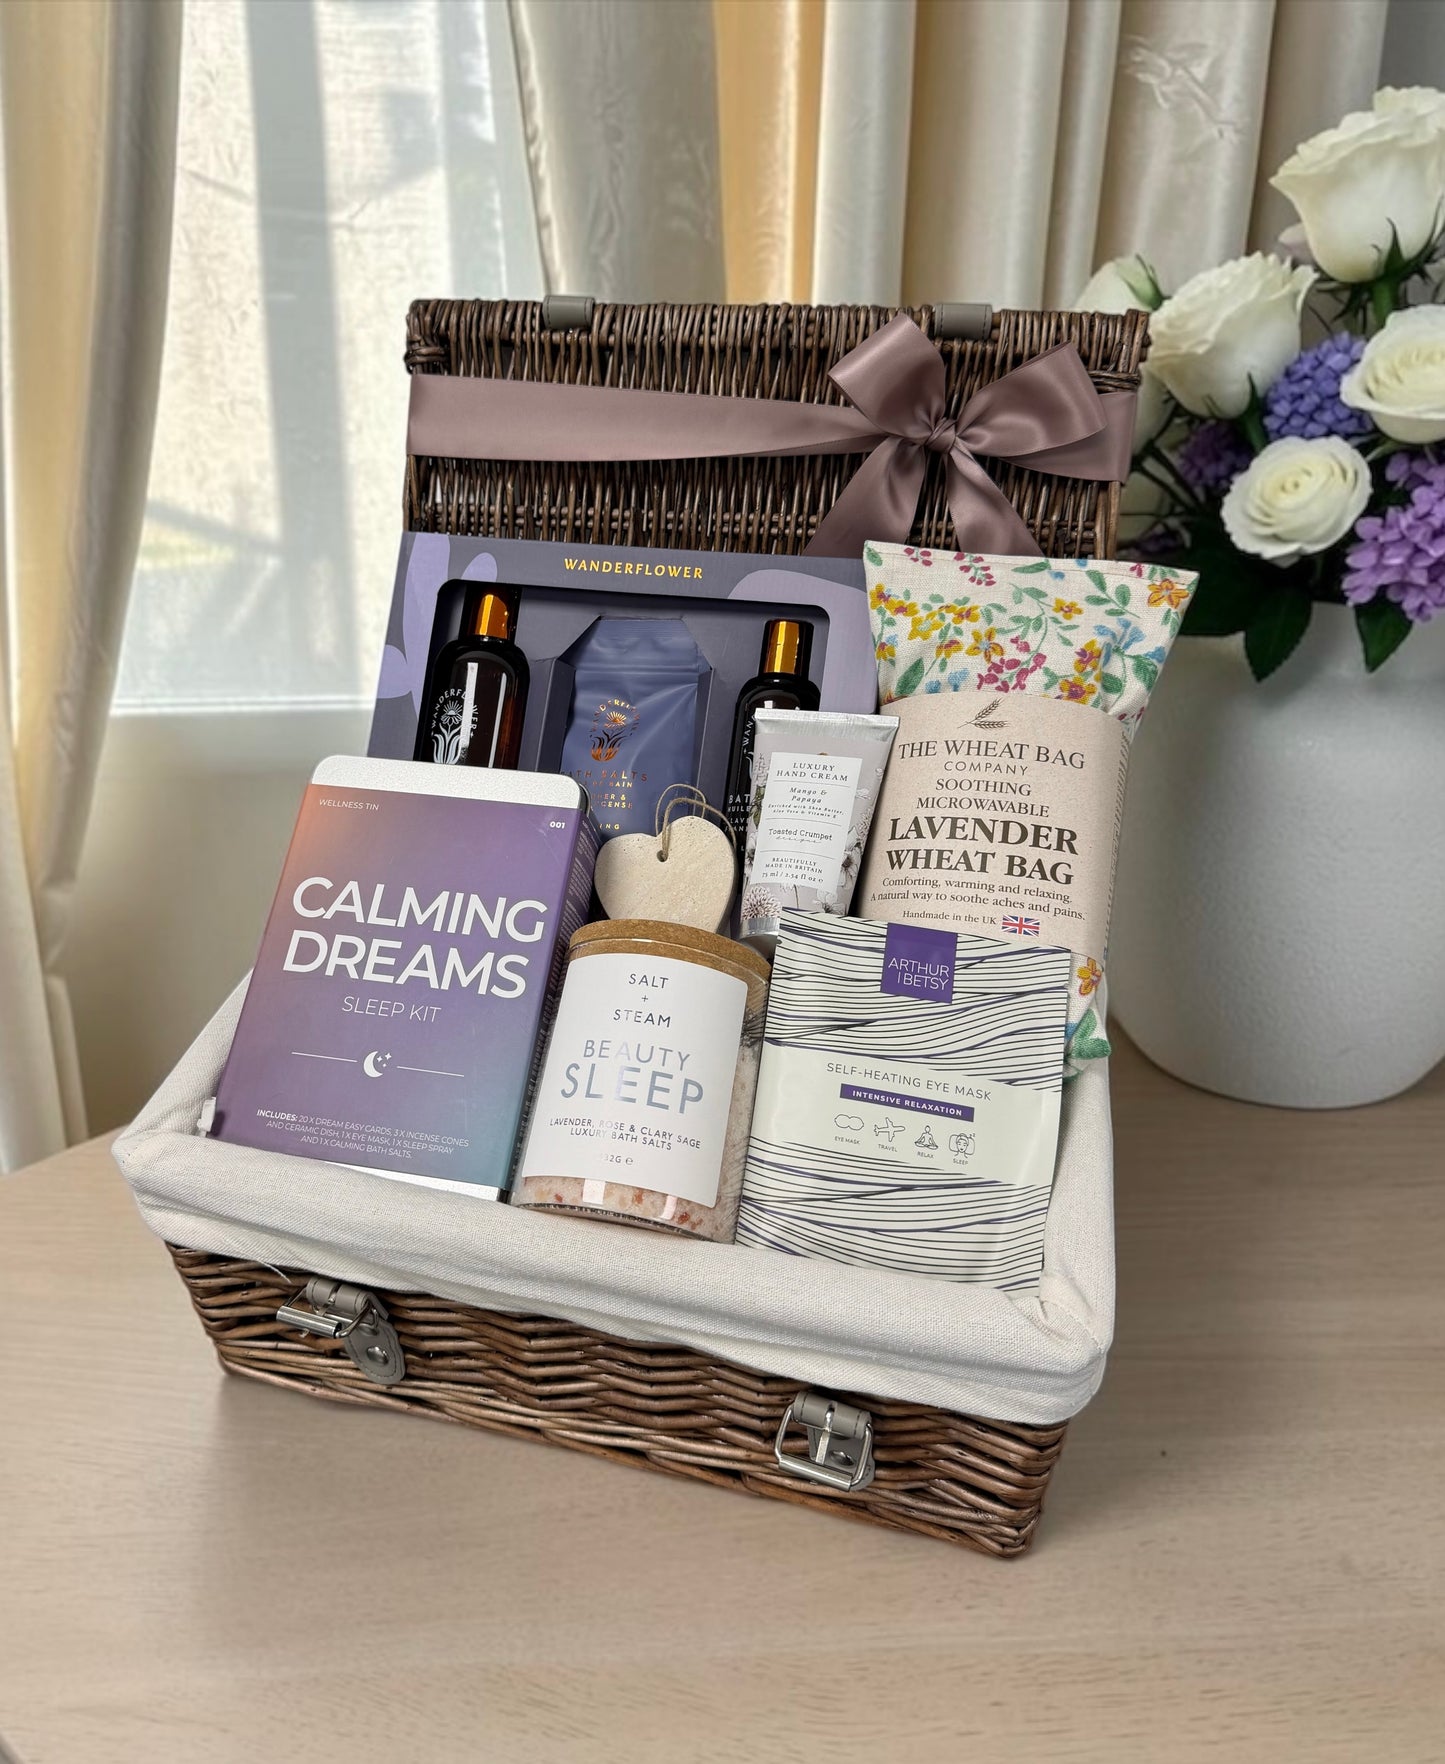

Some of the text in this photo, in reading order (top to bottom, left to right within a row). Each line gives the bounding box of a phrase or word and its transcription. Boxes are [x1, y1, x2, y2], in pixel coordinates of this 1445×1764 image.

[564, 558, 703, 579] WANDERFLOWER
[899, 739, 1086, 769] THE WHEAT BAG
[602, 770, 648, 782] SALTS
[776, 770, 848, 782] HAND CREAM
[793, 762, 835, 772] LUXURY
[944, 761, 1029, 776] COMPANY
[789, 787, 816, 796] Mango
[935, 778, 1032, 797] SOOTHING
[319, 799, 380, 811] WELLNESS TIN
[792, 795, 822, 805] Papaya
[916, 796, 1049, 818] MICROWAVABLE
[549, 821, 566, 829] 001
[768, 828, 832, 841] Toasted Crumpet
[887, 816, 1079, 855] LAVENDER
[772, 857, 817, 866] BEAUTIFULLY
[795, 864, 823, 874] BRITAIN
[886, 848, 1074, 885] WHEAT BAG
[882, 876, 1073, 904] Comforting, warming and relaxing.
[292, 876, 548, 943] CALMING
[870, 890, 1086, 920] A natural way to soothe aches and pains.
[902, 910, 997, 925] Handmade in the UK
[283, 929, 530, 999] DREAMS
[888, 957, 949, 978] ARTHUR
[629, 973, 669, 989] SALT
[903, 973, 949, 992] BETSY
[641, 995, 649, 1003] +
[341, 996, 442, 1023] SLEEP KIT
[613, 1008, 671, 1028] STEAM
[583, 1039, 690, 1071] BEAUTY
[560, 1063, 704, 1114] SLEEP
[827, 1062, 992, 1101] SELF-HEATING EYE MASK
[852, 1090, 963, 1116] INTENSIVE RELAXATION
[256, 1109, 470, 1148] INCLUDES: 20 X DREAM EASY CARDS, 3 X INCENSE CONES
[266, 1120, 284, 1129] AND
[284, 1122, 320, 1135] CERAMIC
[320, 1128, 340, 1139] DISH,
[345, 1131, 352, 1140] X
[351, 1132, 368, 1142] EYE
[368, 1135, 390, 1146] MASK,
[395, 1139, 403, 1147] X
[403, 1140, 428, 1151] SLEEP
[428, 1144, 454, 1156] SPRAY
[549, 1117, 701, 1150] LAVENDER, ROSE & CLARY SAGE
[300, 1135, 319, 1145] AND
[323, 1138, 329, 1146] X
[330, 1139, 365, 1151] CALMING
[366, 1144, 388, 1155] BATH
[388, 1147, 413, 1159] SALTS.
[570, 1127, 672, 1151] LUXURY BATH SALTS
[845, 1137, 861, 1145] MASK
[877, 1143, 898, 1153] TRAVEL
[917, 1151, 934, 1159] RELAX
[952, 1158, 969, 1166] SLEEP
